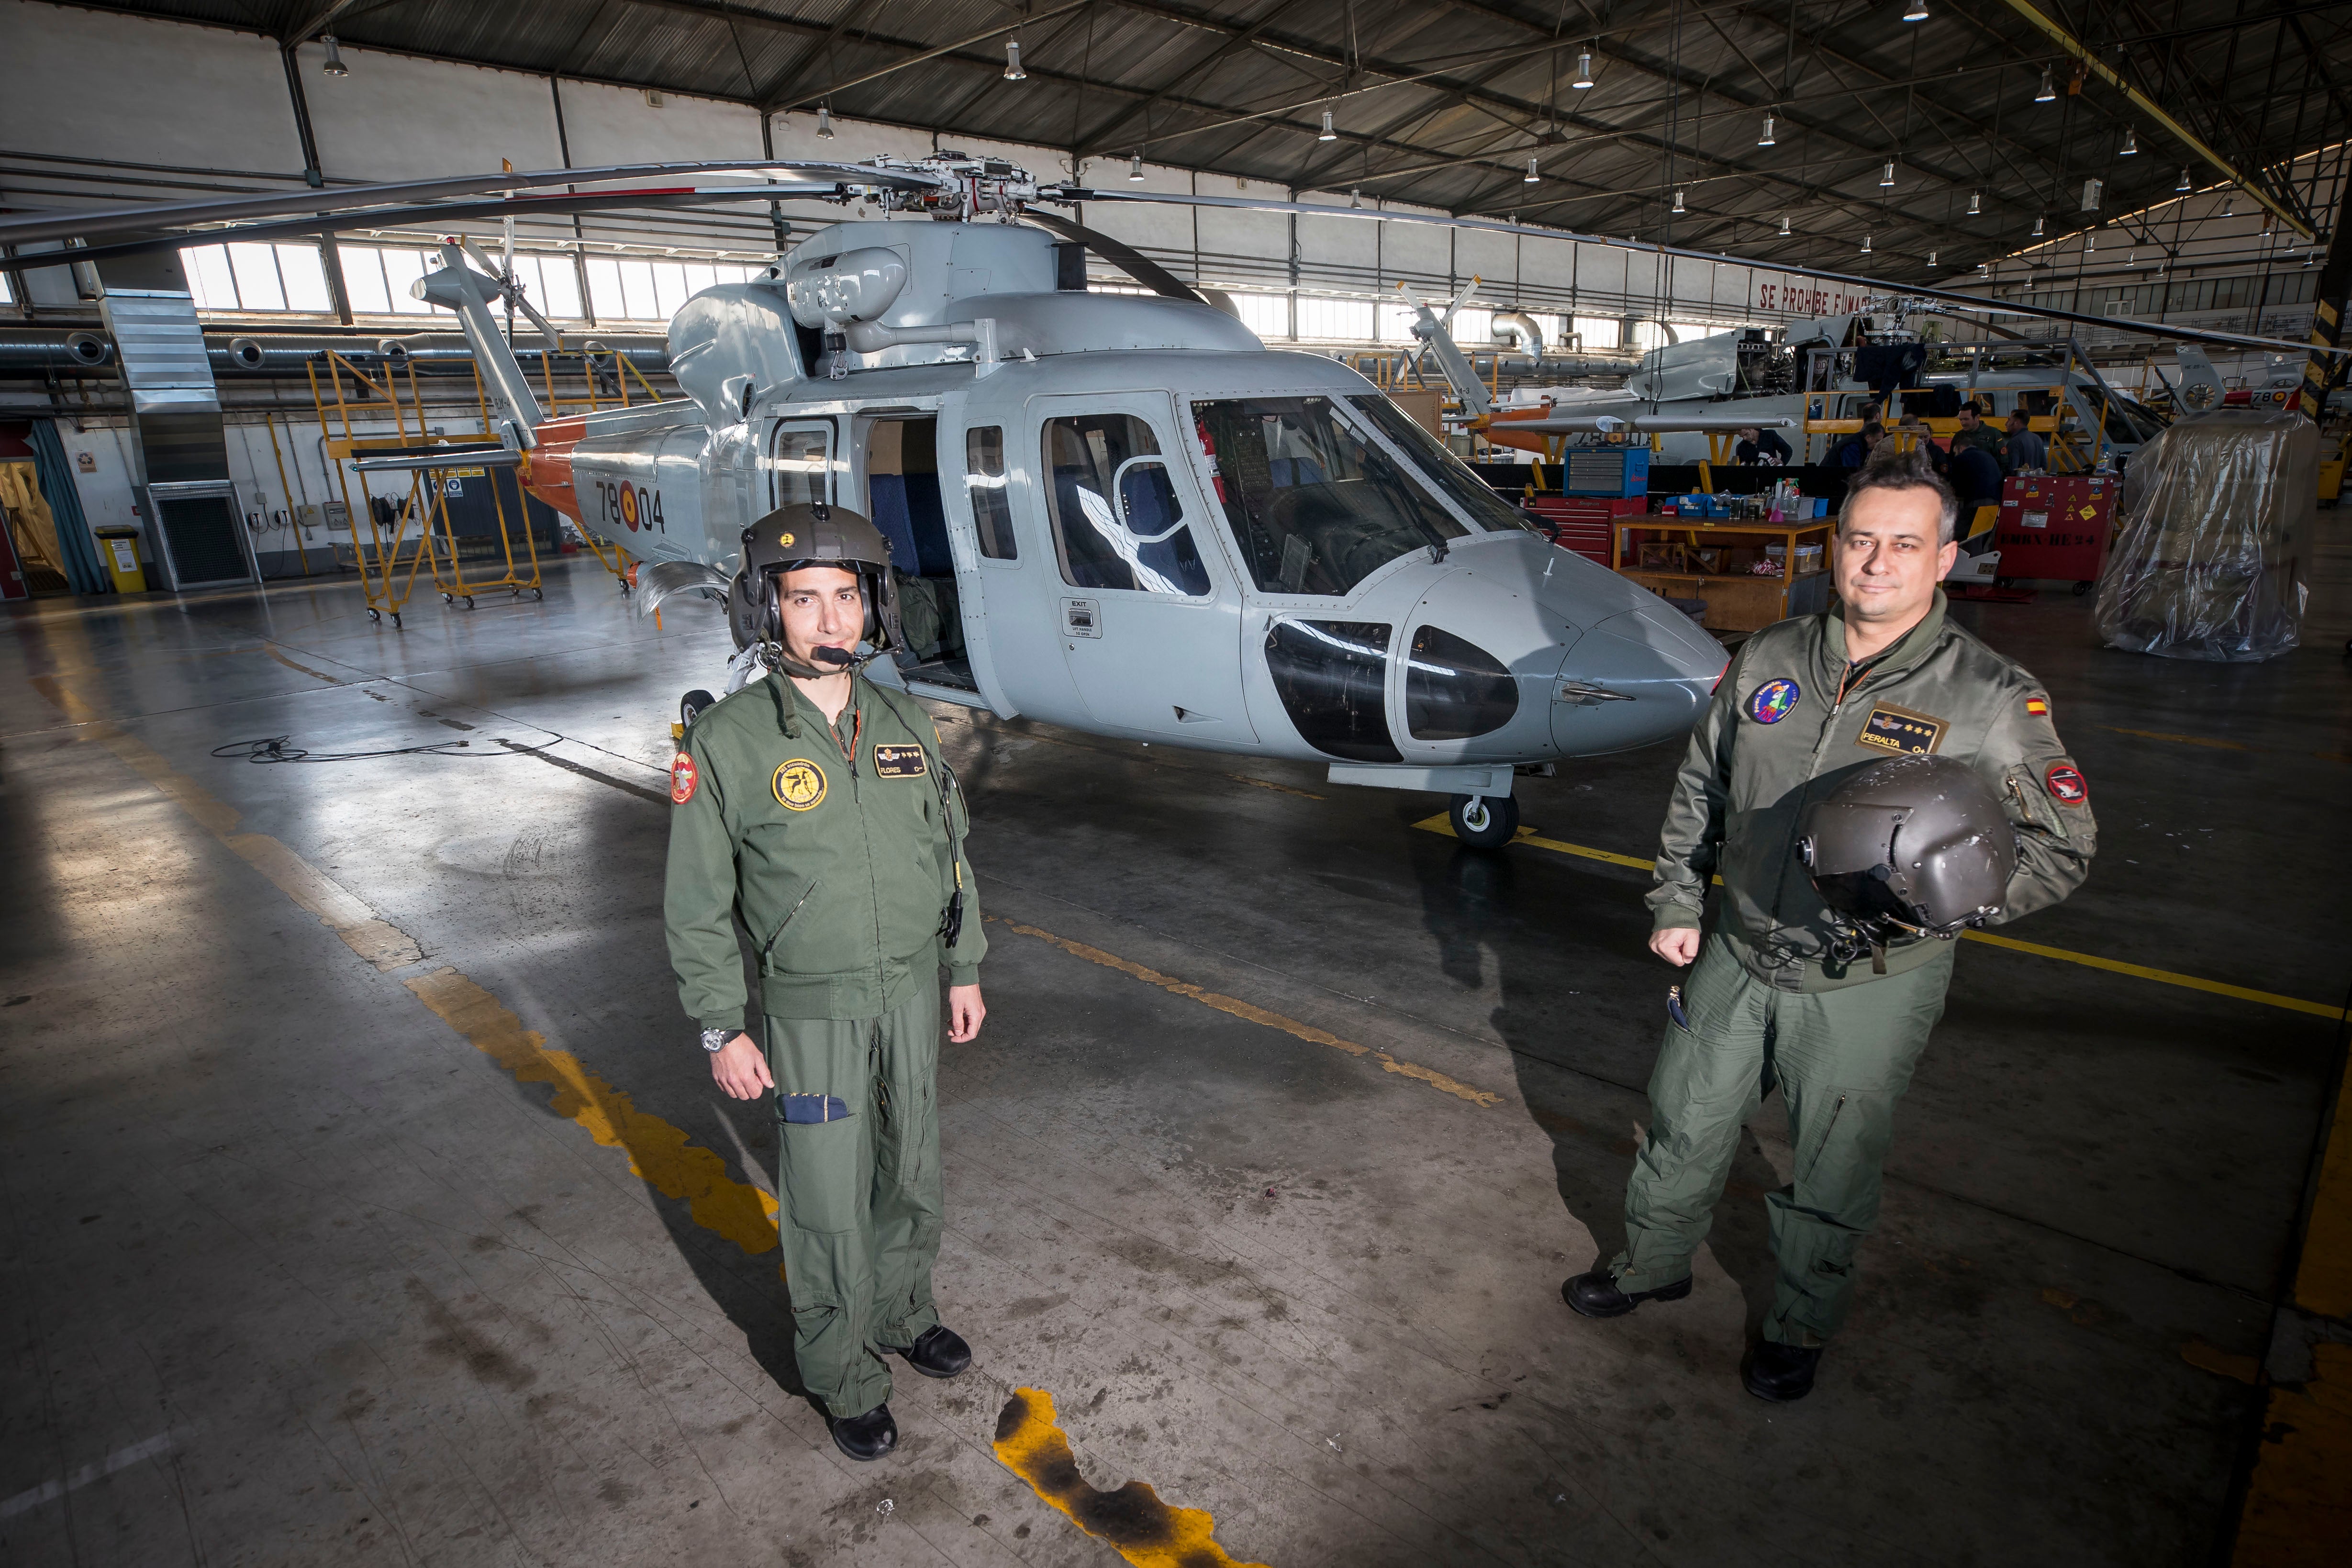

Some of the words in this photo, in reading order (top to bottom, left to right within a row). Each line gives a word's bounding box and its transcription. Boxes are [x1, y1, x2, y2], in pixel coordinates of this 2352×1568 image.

[1760, 284, 1776, 309] SE
[1783, 287, 1829, 314] PROHIBE
[2253, 392, 2271, 402] 78
[596, 481, 621, 525] 78
[638, 487, 665, 534] 04
[1862, 732, 1900, 748] PERALTA
